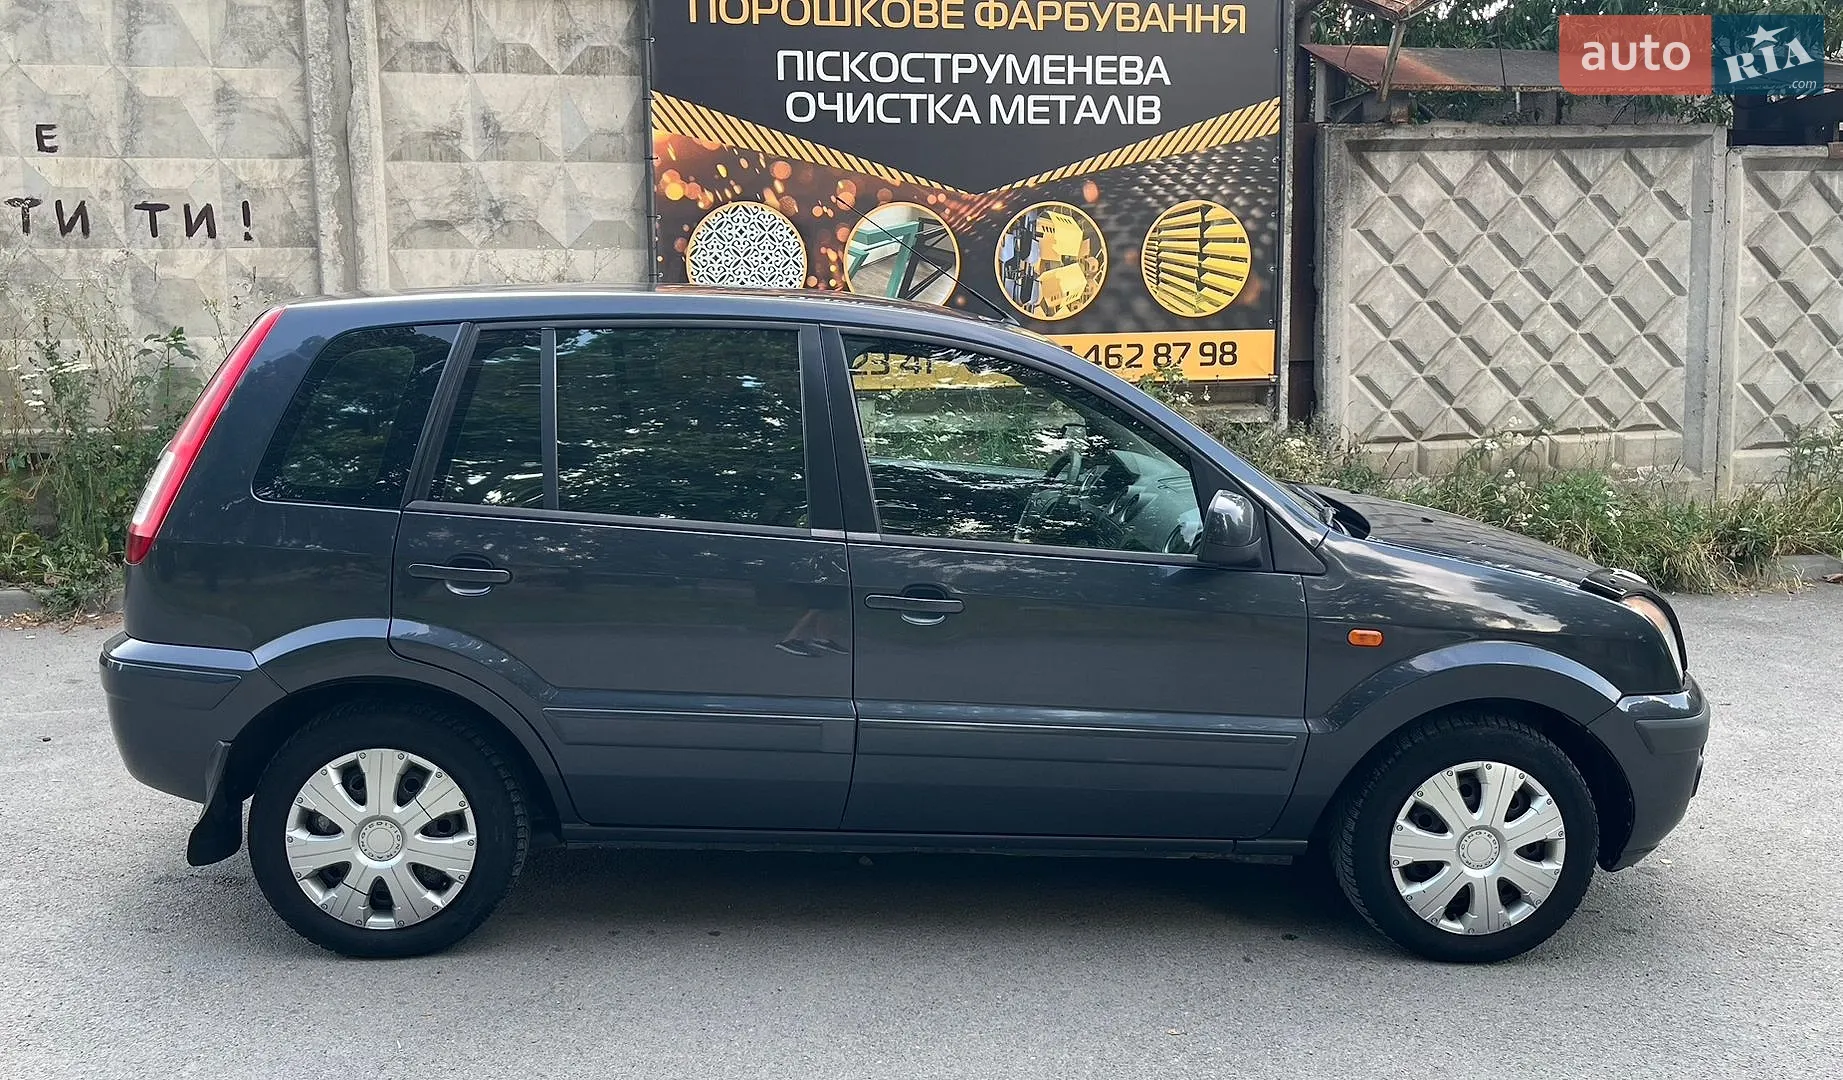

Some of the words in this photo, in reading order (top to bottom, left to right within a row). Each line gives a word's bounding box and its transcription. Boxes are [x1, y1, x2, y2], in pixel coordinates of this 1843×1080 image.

[688, 0, 965, 29] ПОРОШКОВЕ
[974, 0, 1246, 34] ФАРБУВАННЯ
[776, 50, 1172, 86] ПІСКОСТРУМЕНЕВА
[786, 91, 982, 125] ОЧИСТКА
[989, 93, 1162, 125] МЕТАЛІВ
[1083, 343, 1144, 369] 462
[1153, 343, 1191, 369] 87
[1200, 341, 1238, 367] 98
